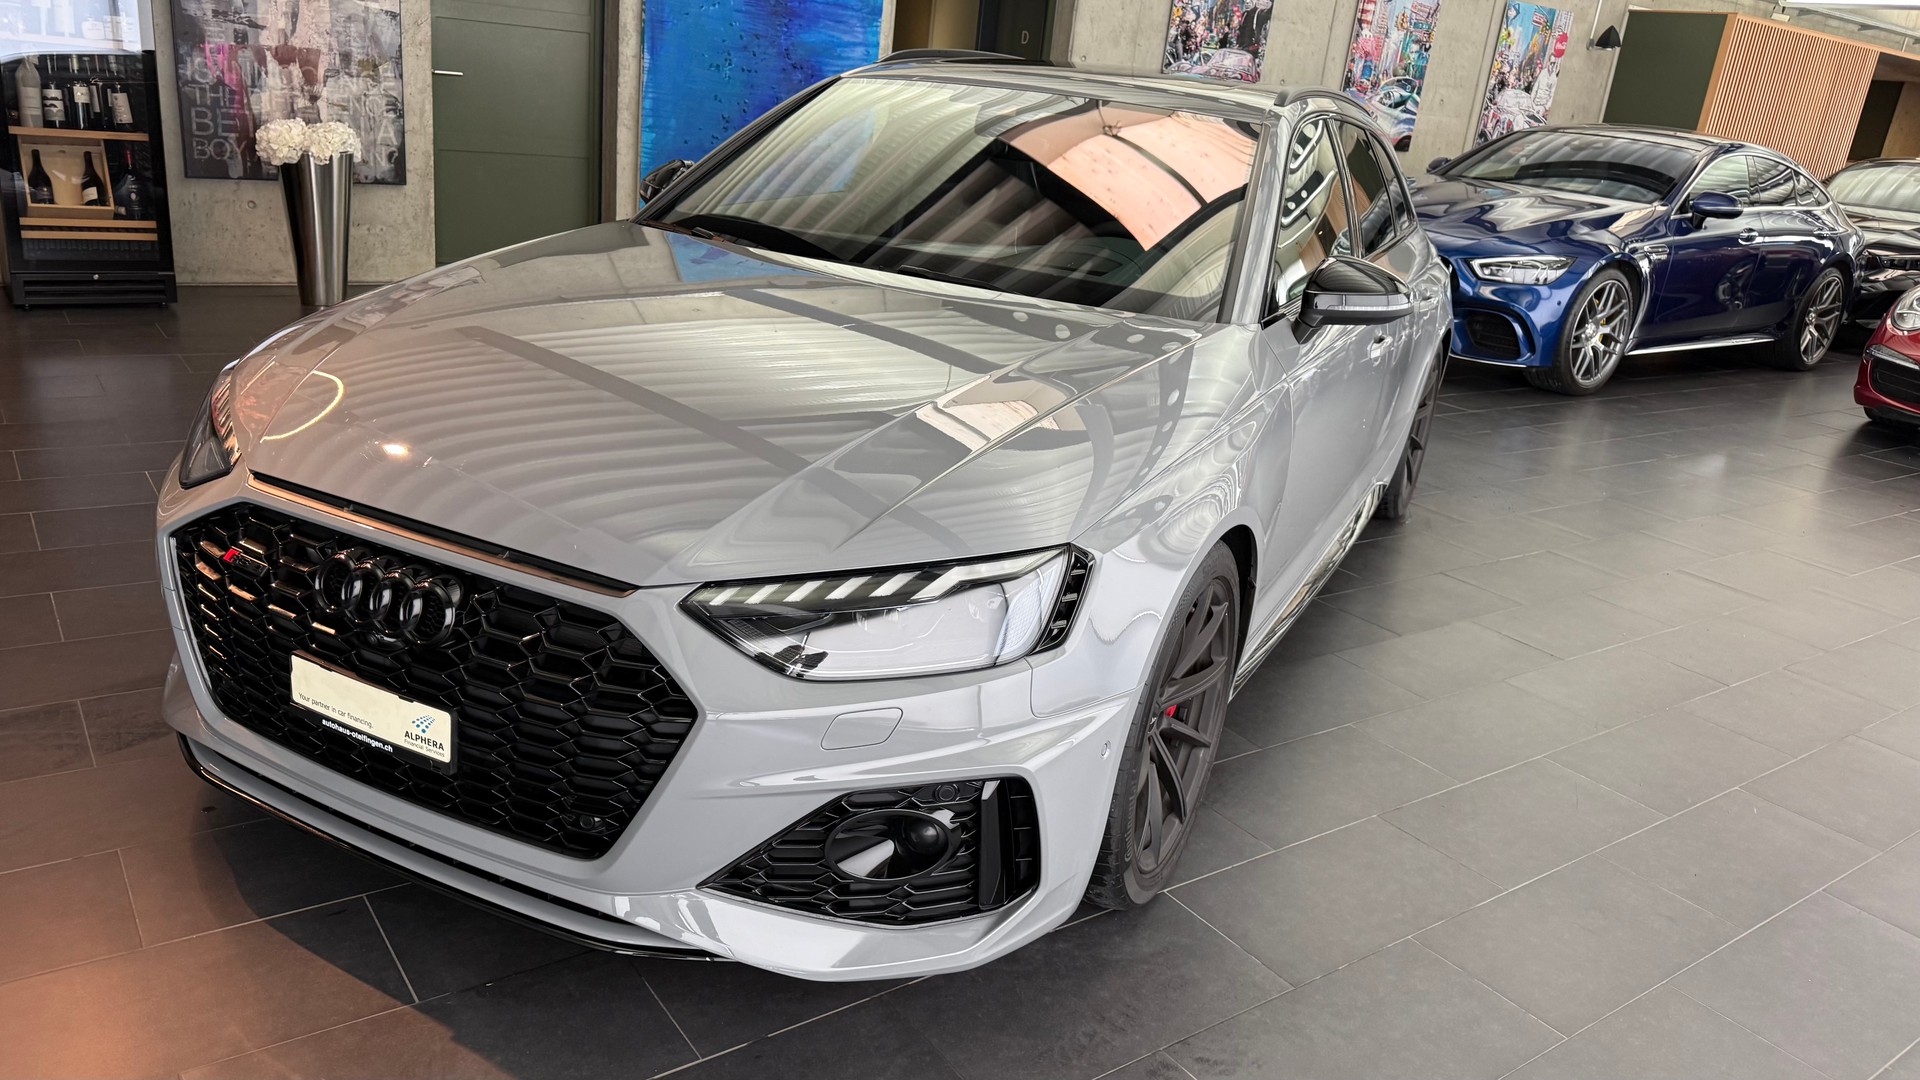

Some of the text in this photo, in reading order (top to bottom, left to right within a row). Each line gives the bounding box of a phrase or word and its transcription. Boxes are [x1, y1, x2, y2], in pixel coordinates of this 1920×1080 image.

[1021, 30, 1030, 45] D
[193, 137, 247, 162] BOY
[298, 692, 374, 729] Your partner in car financing.
[321, 718, 393, 753] autohaus-otelfingen.ch
[404, 730, 445, 751] ALPHERA
[404, 738, 445, 758] Financial Services
